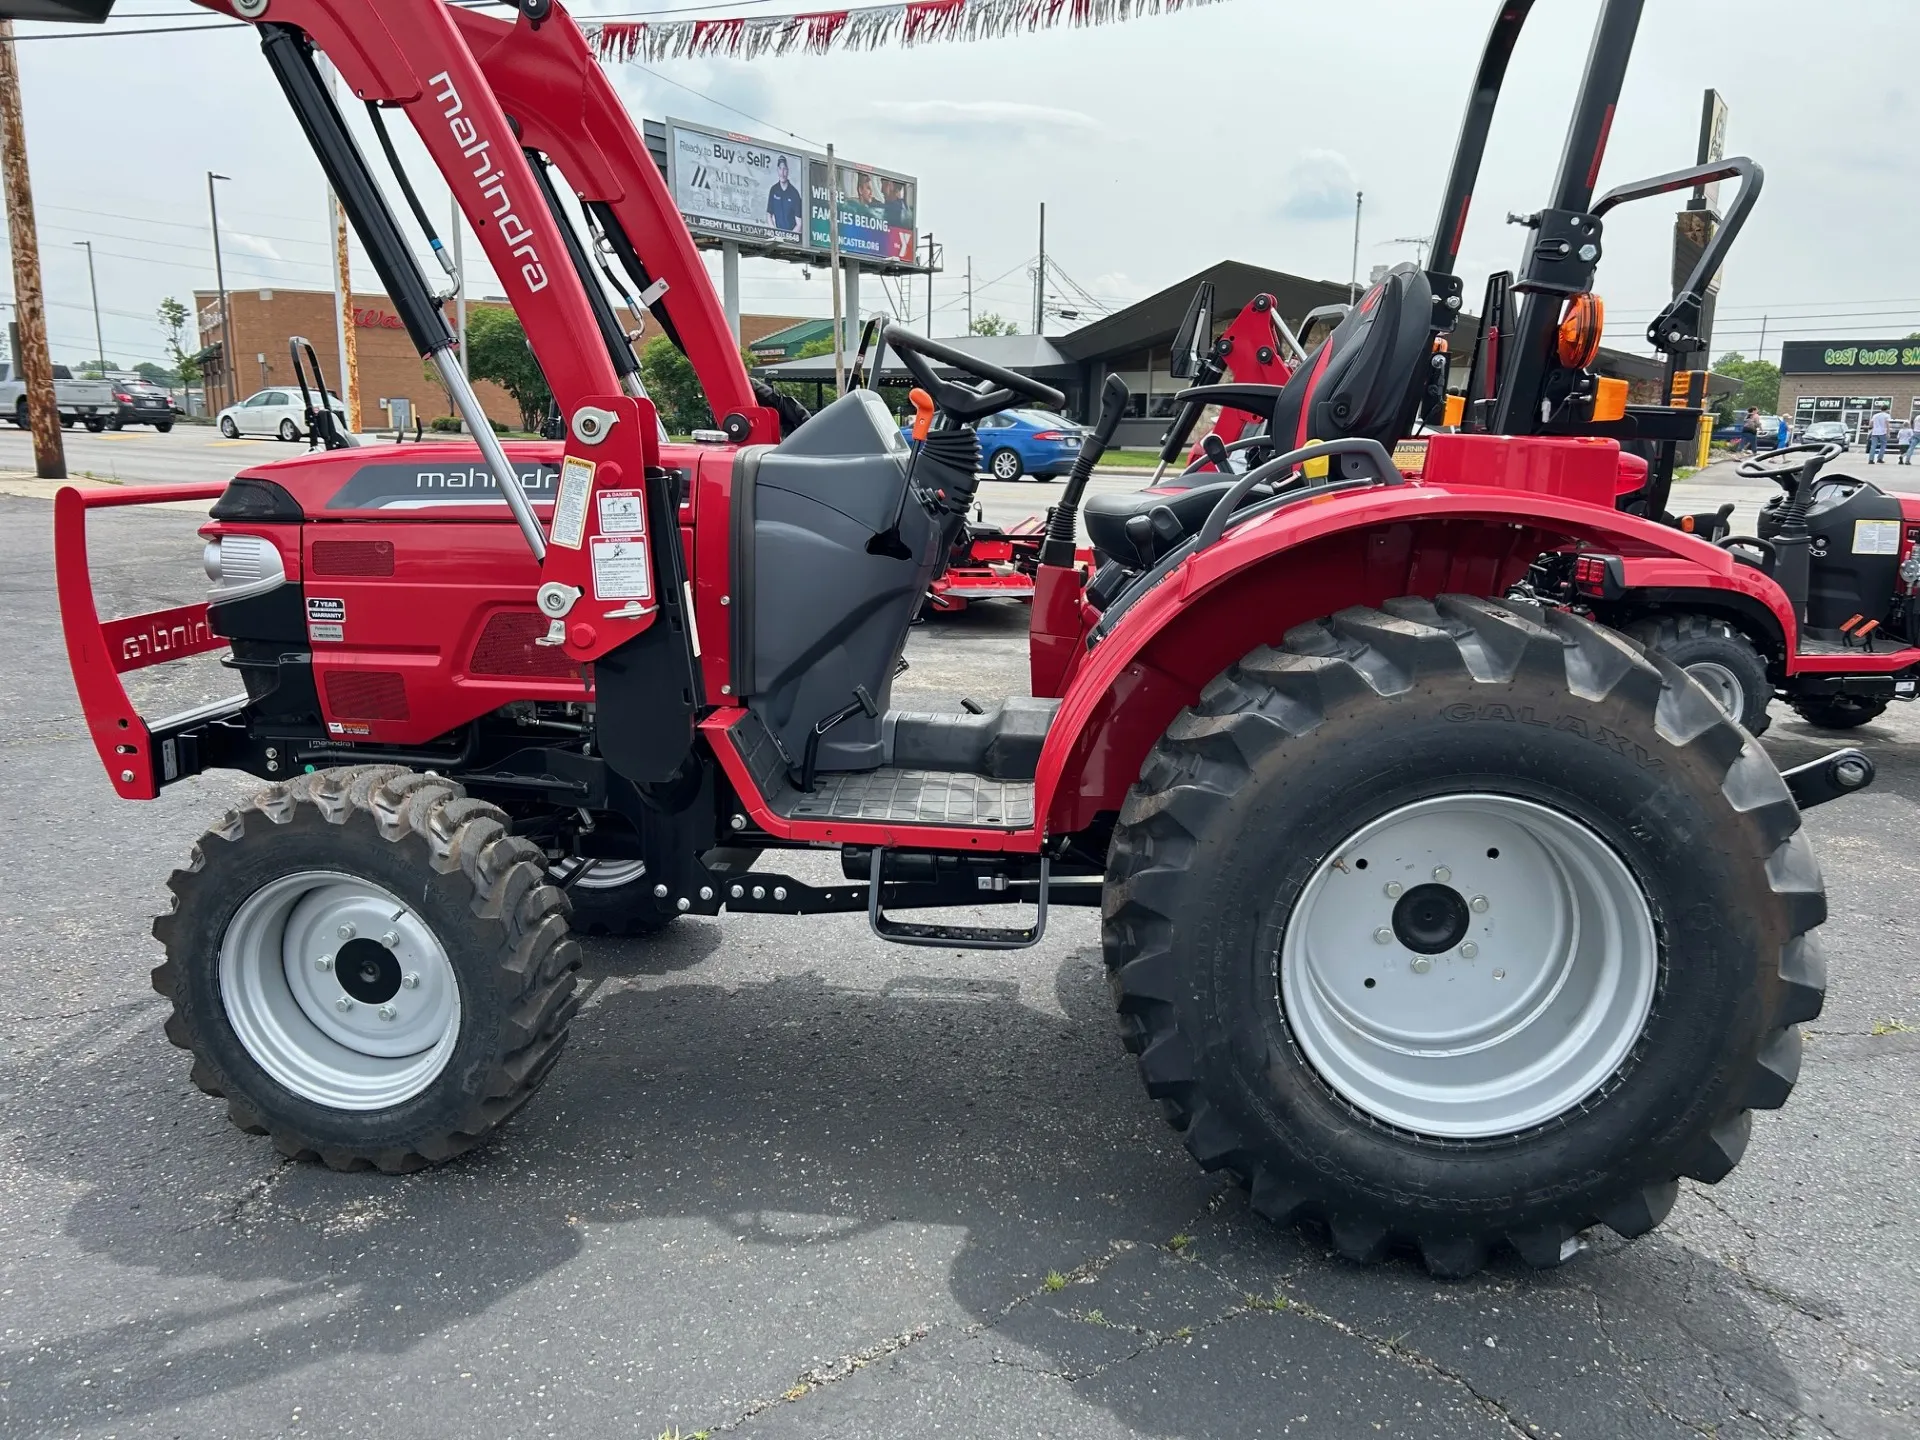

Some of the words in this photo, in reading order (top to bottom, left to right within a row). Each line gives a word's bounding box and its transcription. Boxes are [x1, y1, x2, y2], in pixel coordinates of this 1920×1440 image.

[679, 140, 702, 155] Ready
[703, 147, 712, 157] to
[713, 144, 736, 164] Buy
[737, 155, 746, 163] or
[746, 151, 771, 169] Sell?
[428, 70, 549, 293] mahindra
[715, 170, 750, 188] MILLS
[681, 214, 698, 226] CALL
[699, 218, 724, 230] JEREMY
[723, 222, 741, 232] MILLS
[854, 215, 891, 233] BELONG.
[811, 231, 880, 251] YMCANCASTER.ORG
[1819, 400, 1841, 408] OPEN
[1394, 445, 1427, 453] WARNIN
[313, 600, 320, 608] 7
[1443, 702, 1666, 773] GALAXY
